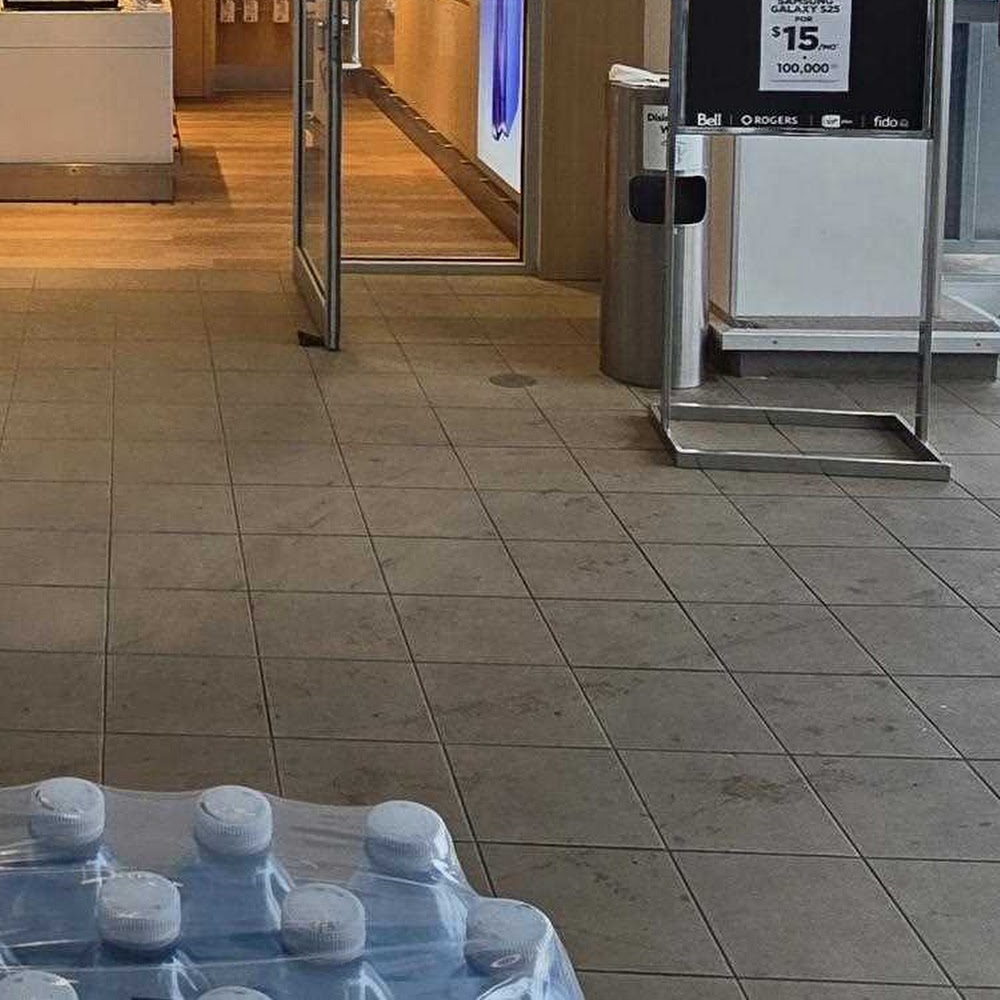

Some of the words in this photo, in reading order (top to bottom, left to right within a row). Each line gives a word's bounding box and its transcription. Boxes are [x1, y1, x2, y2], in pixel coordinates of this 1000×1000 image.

[771, 5, 817, 13] GALAXY
[820, 5, 840, 13] S25
[777, 62, 829, 74] 100,000
[697, 113, 721, 126] Bell
[754, 115, 799, 125] ROGERS
[873, 115, 898, 128] fido
